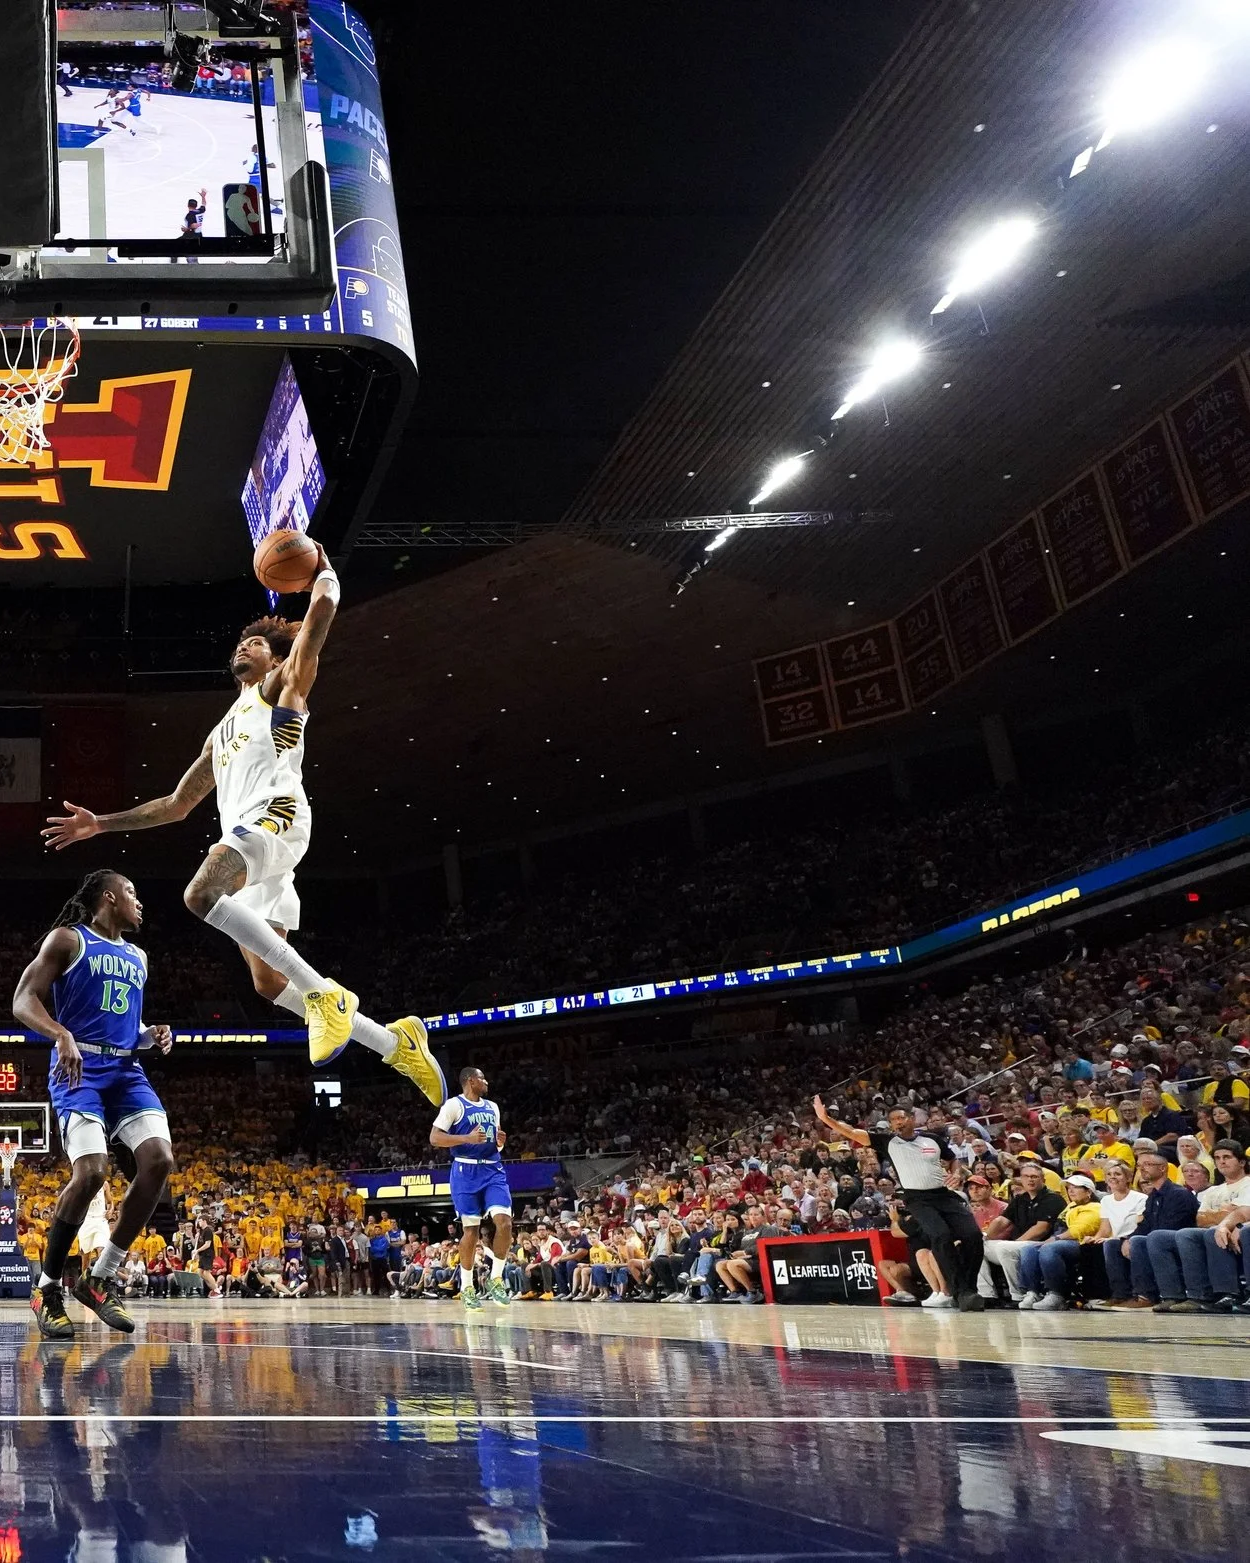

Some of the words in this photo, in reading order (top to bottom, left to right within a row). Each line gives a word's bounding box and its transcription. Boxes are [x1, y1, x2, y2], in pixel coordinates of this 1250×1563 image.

[330, 93, 389, 155] PACE
[144, 318, 158, 328] 27
[161, 318, 199, 329] GOBERT
[256, 320, 264, 329] 2
[279, 320, 287, 330] 5
[305, 321, 310, 331] 1
[324, 321, 332, 331] 0
[362, 310, 374, 327] 5
[841, 638, 879, 663] 44
[772, 660, 803, 682] 14
[854, 681, 883, 707] 14
[778, 701, 815, 725] 32
[816, 965, 823, 973] 3
[879, 956, 886, 964] 4
[88, 953, 144, 990] WOLVES
[787, 969, 795, 977] 11
[100, 979, 131, 1015] 13
[563, 995, 586, 1009] 41.7
[632, 987, 644, 998] 21
[522, 1003, 534, 1014] 30
[401, 1174, 431, 1186] INDIANA
[790, 1265, 840, 1278] LEARFIELD
[846, 1263, 878, 1281] STATE
